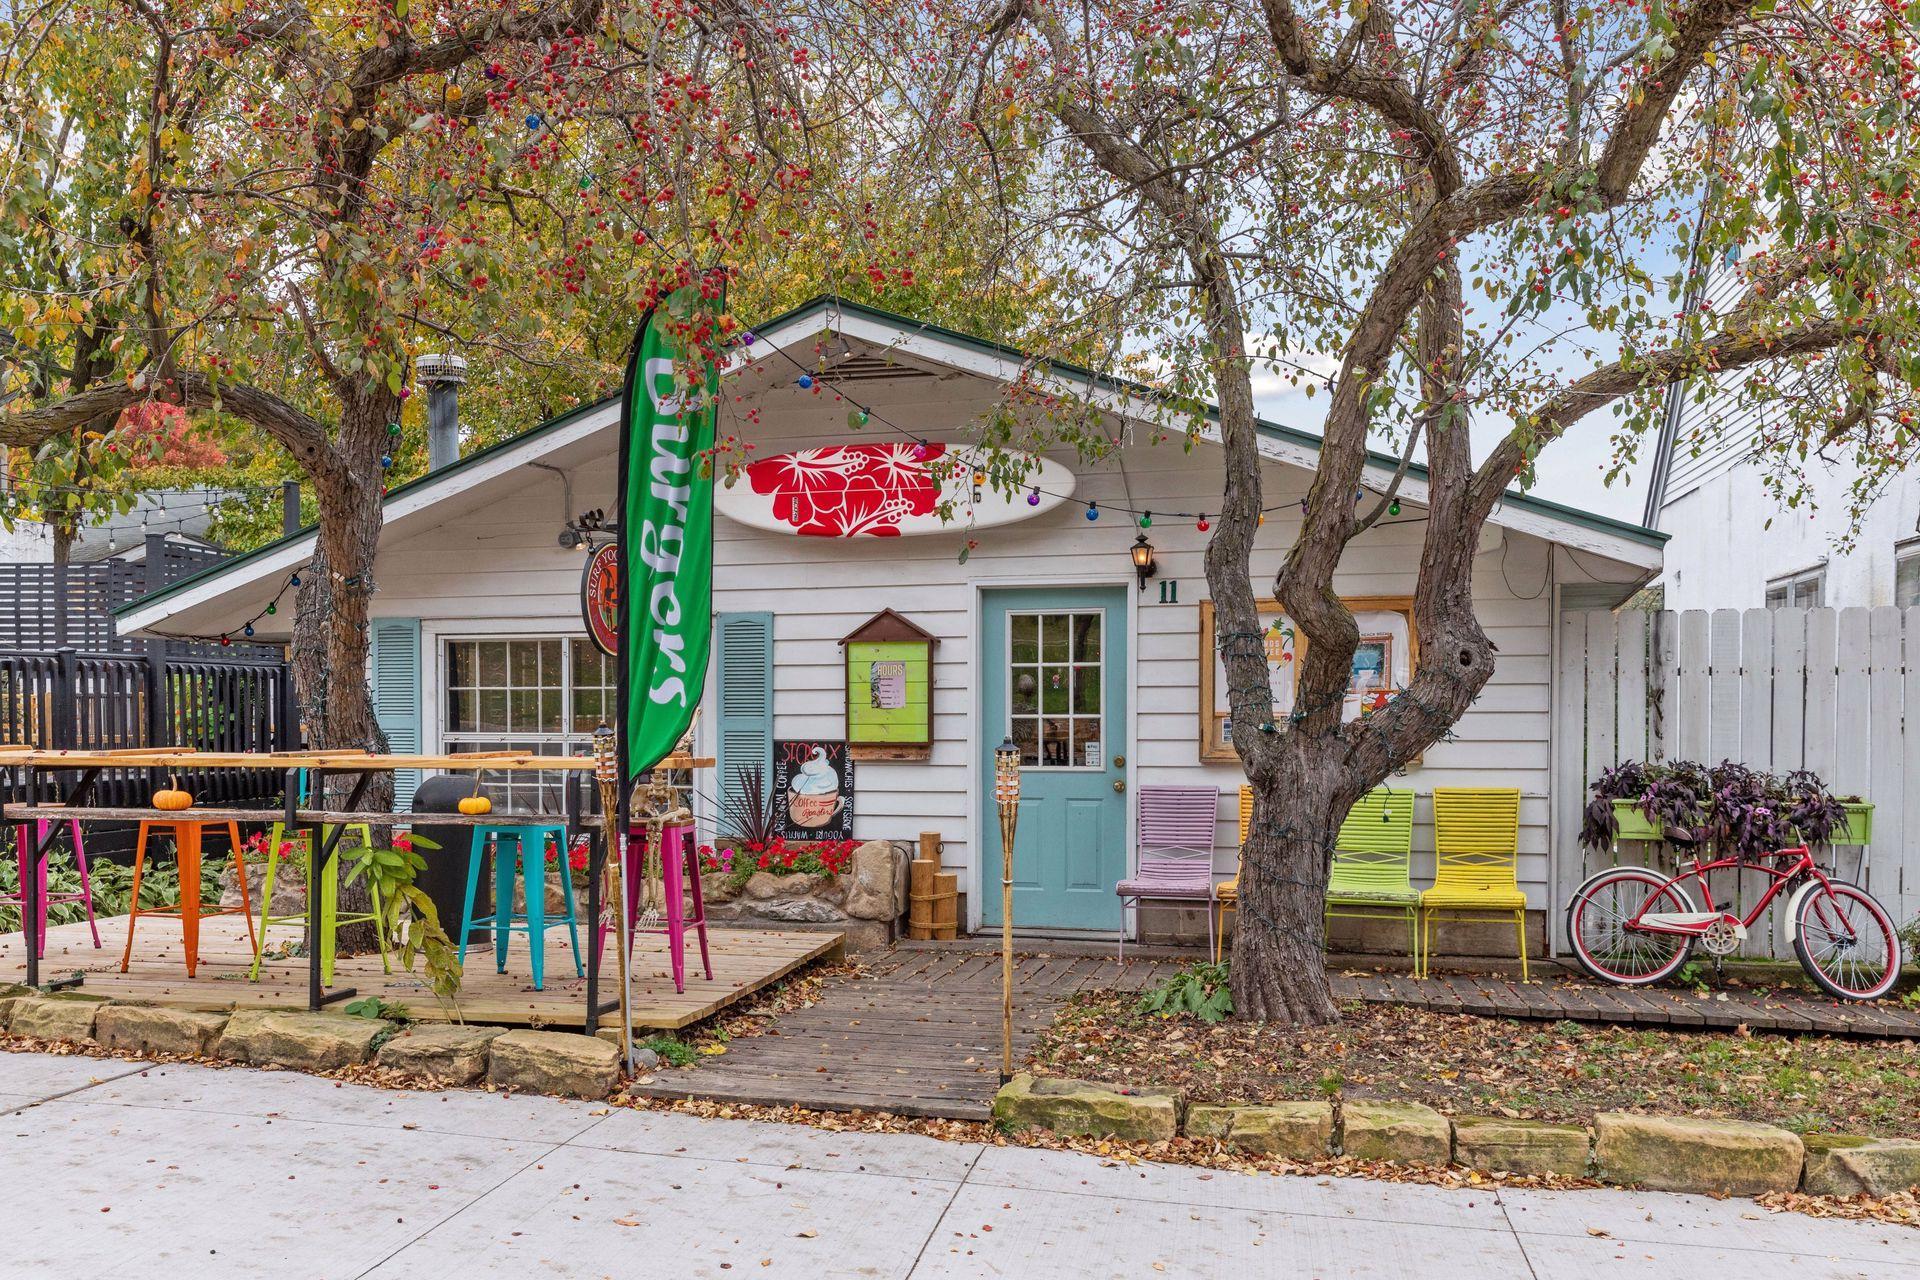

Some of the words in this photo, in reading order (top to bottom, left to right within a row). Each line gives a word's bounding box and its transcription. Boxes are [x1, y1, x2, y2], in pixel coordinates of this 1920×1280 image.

[590, 560, 602, 598] SURF
[1159, 581, 1178, 603] 11
[878, 664, 902, 676] HOURS
